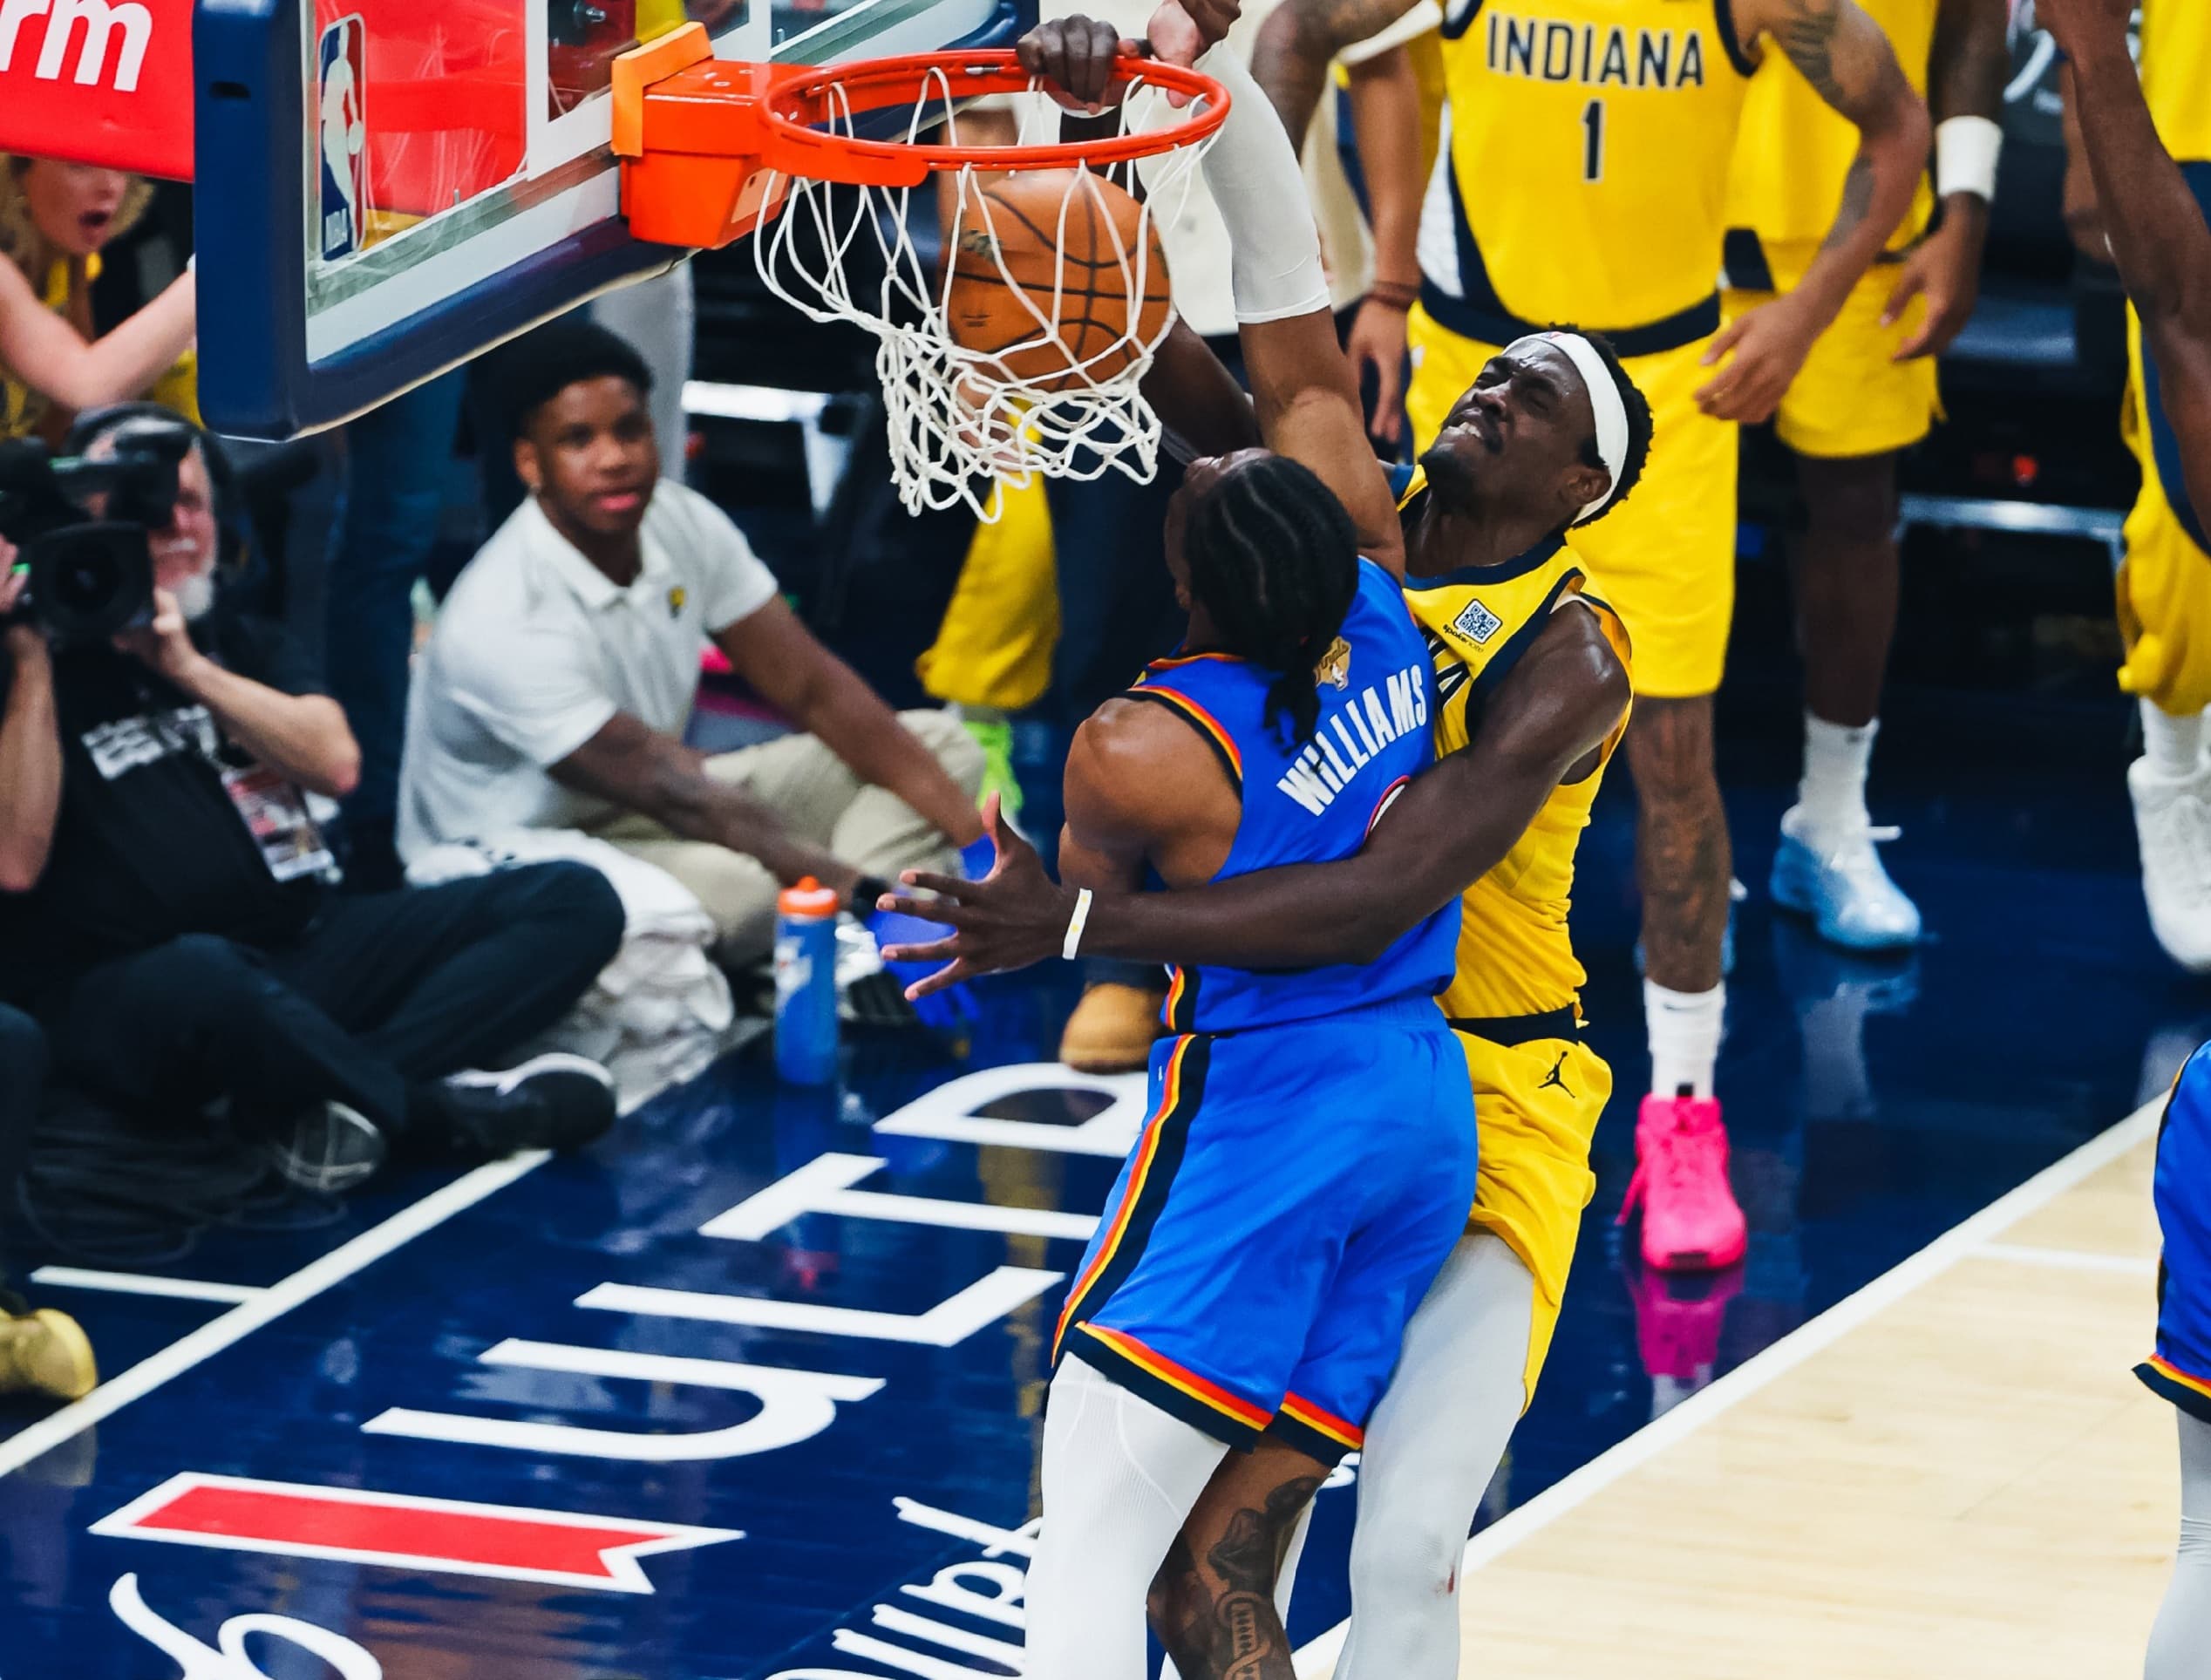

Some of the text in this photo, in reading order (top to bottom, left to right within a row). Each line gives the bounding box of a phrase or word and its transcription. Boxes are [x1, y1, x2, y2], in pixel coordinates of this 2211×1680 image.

[1487, 12, 1704, 90] INDIANA
[1582, 99, 1606, 182] 1
[1276, 664, 1427, 817] WILLIAMS
